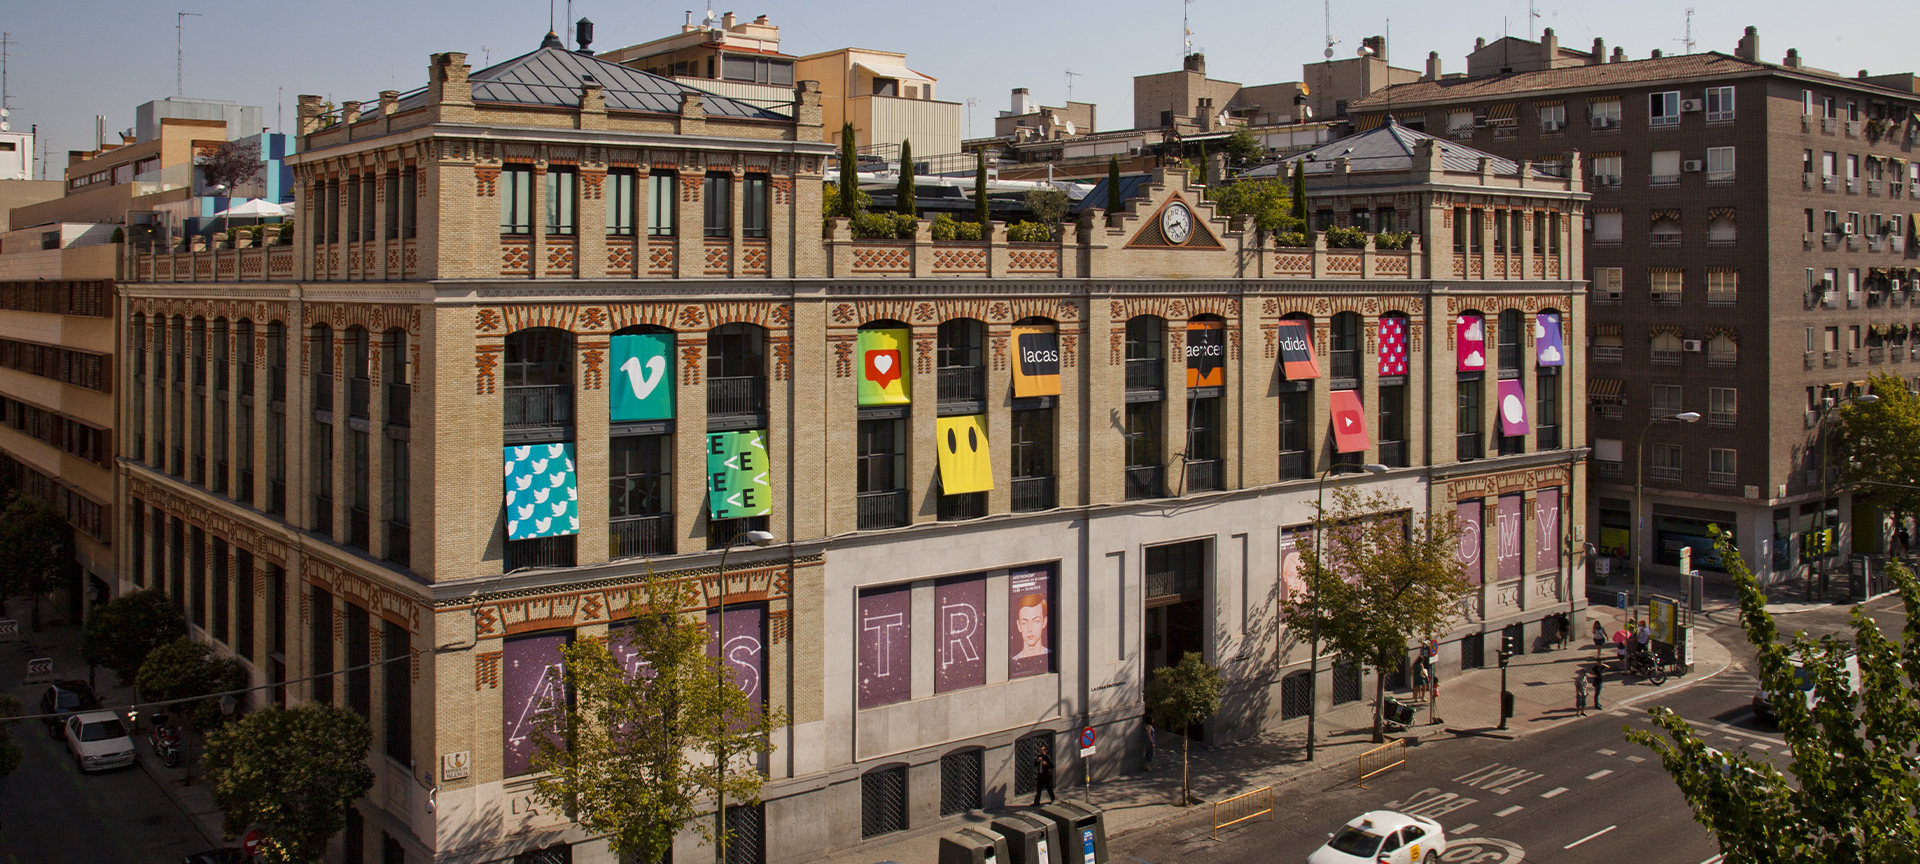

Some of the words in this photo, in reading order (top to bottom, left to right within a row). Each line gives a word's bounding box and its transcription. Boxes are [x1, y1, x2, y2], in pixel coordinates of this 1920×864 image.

[1023, 346, 1058, 363] lacas
[864, 612, 902, 677] T
[942, 603, 979, 666] R
[1451, 763, 1544, 795] TAXI
[1383, 787, 1479, 819] BUS
